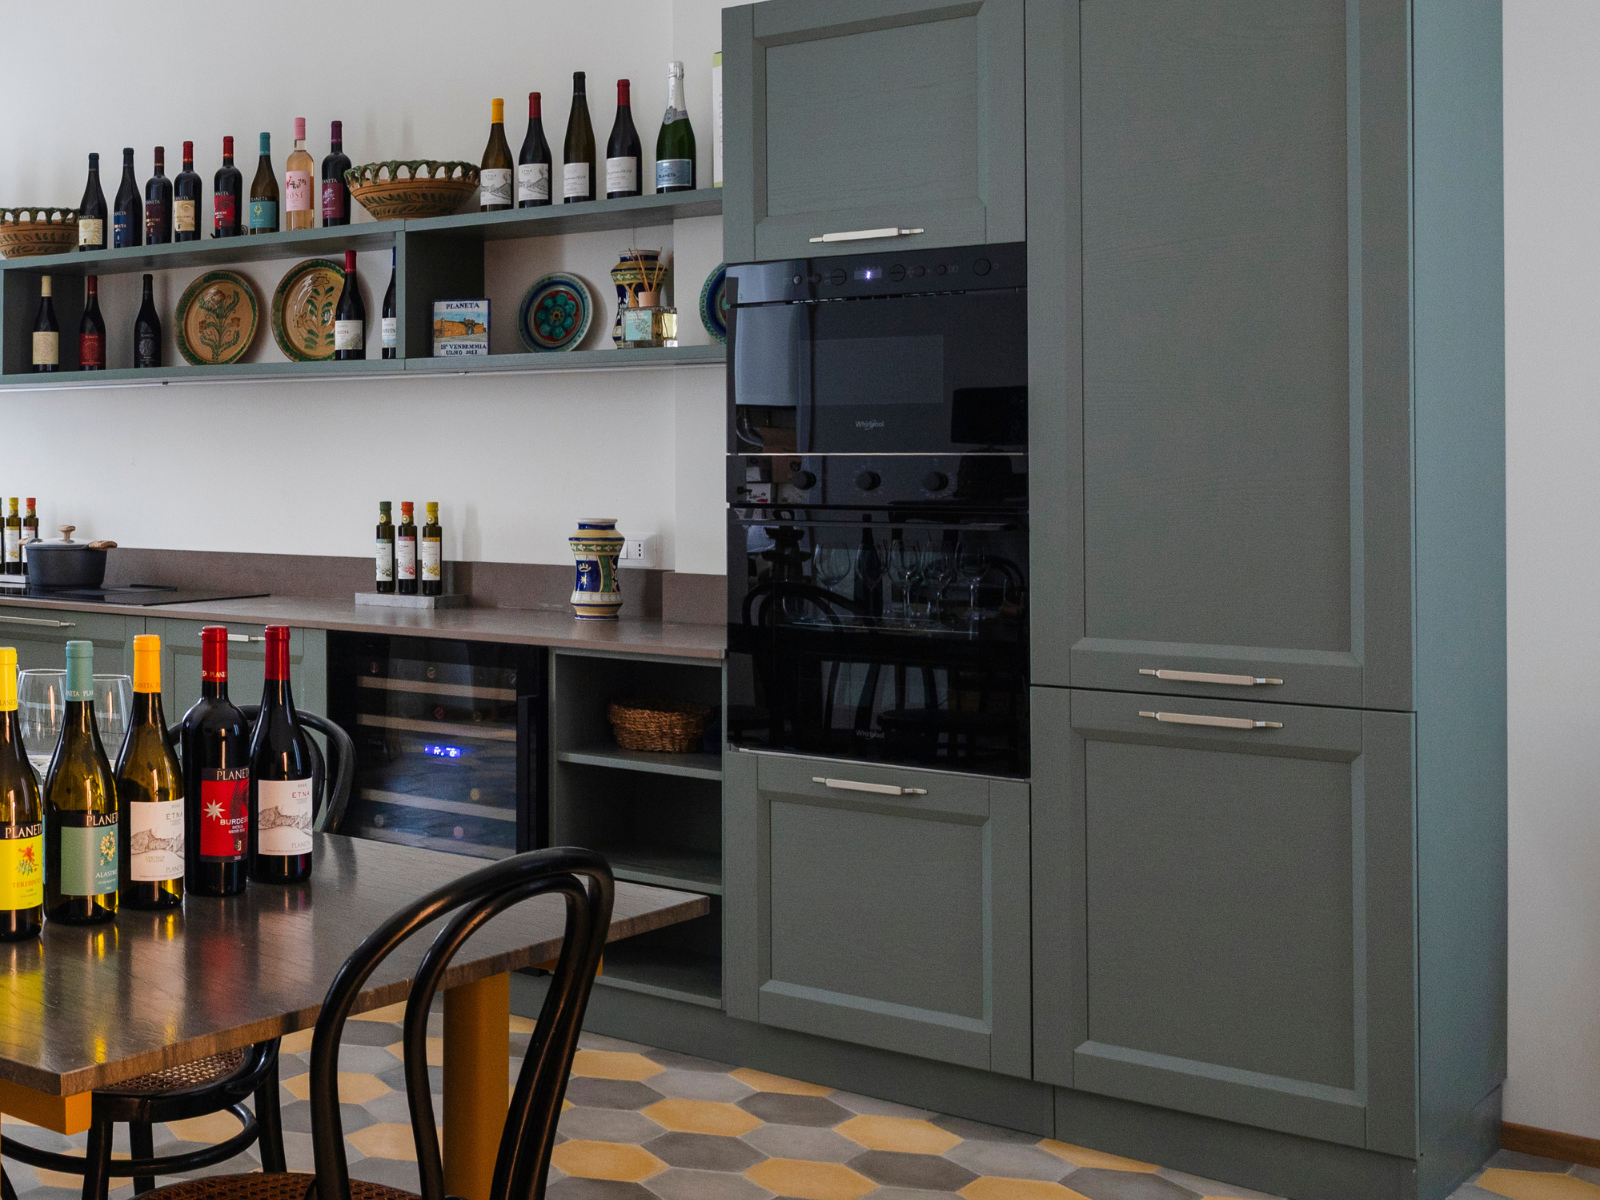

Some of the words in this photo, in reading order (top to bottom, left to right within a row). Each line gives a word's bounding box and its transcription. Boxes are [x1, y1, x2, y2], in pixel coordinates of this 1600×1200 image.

[445, 302, 480, 310] PLANETA
[291, 790, 310, 799] ETNA
[166, 811, 183, 820] ETNA
